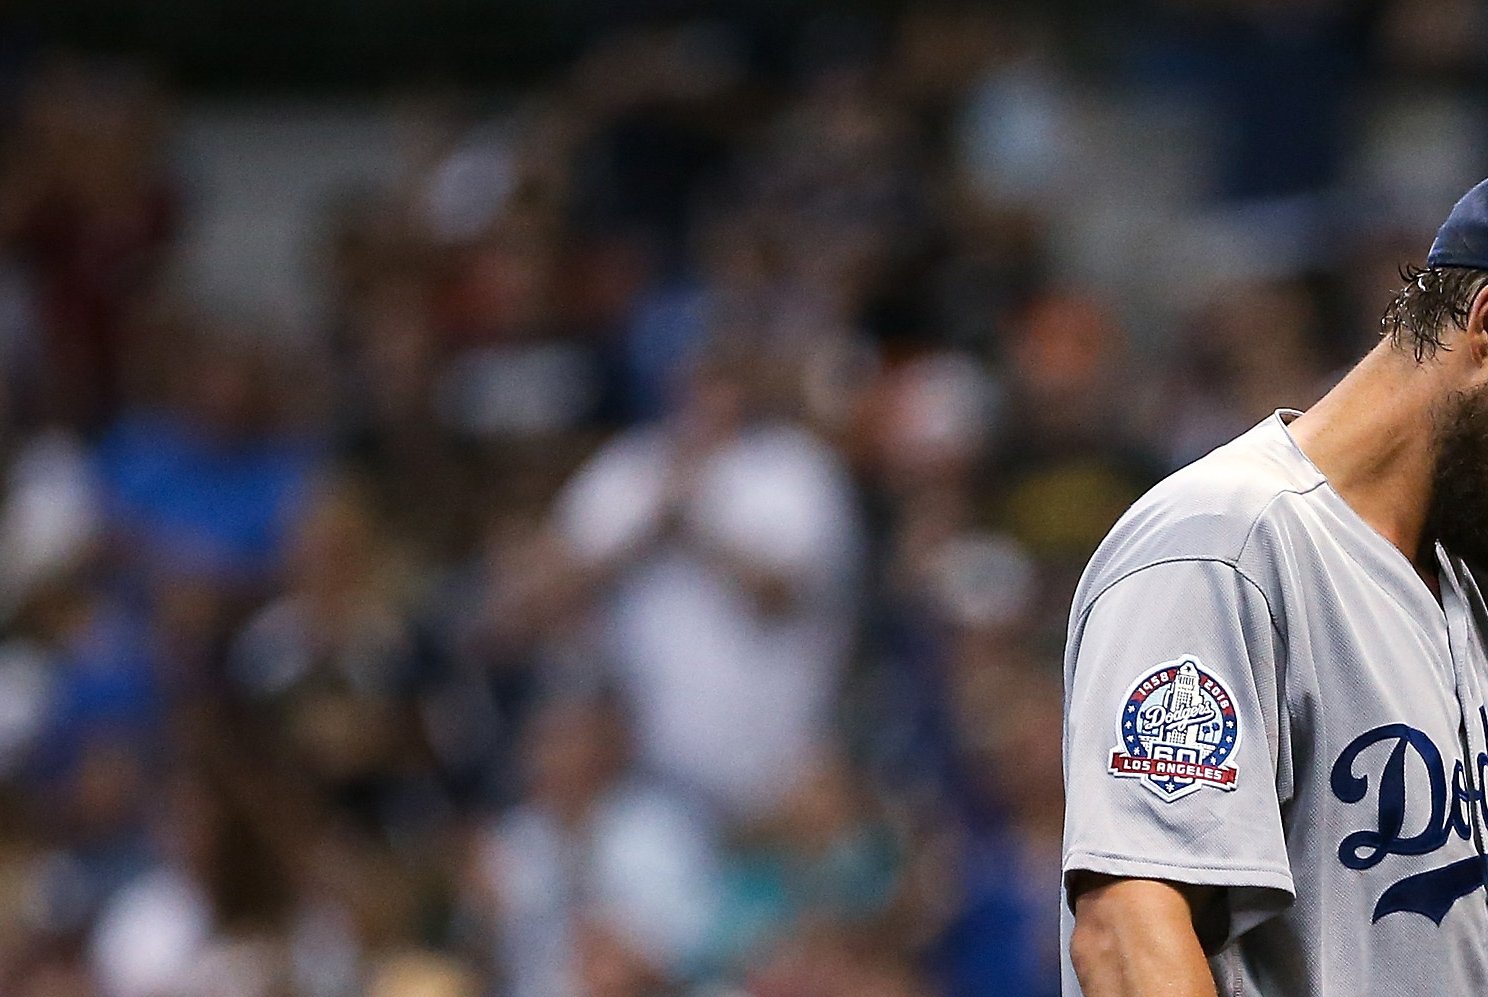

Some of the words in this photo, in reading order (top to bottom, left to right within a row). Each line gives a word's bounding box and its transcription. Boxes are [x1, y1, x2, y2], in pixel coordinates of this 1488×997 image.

[1138, 672, 1169, 696] 1958
[1204, 680, 1230, 709] 2018
[1145, 702, 1215, 731] Dodgers
[1123, 759, 1151, 771] LOS
[1156, 762, 1223, 781] ANGELES
